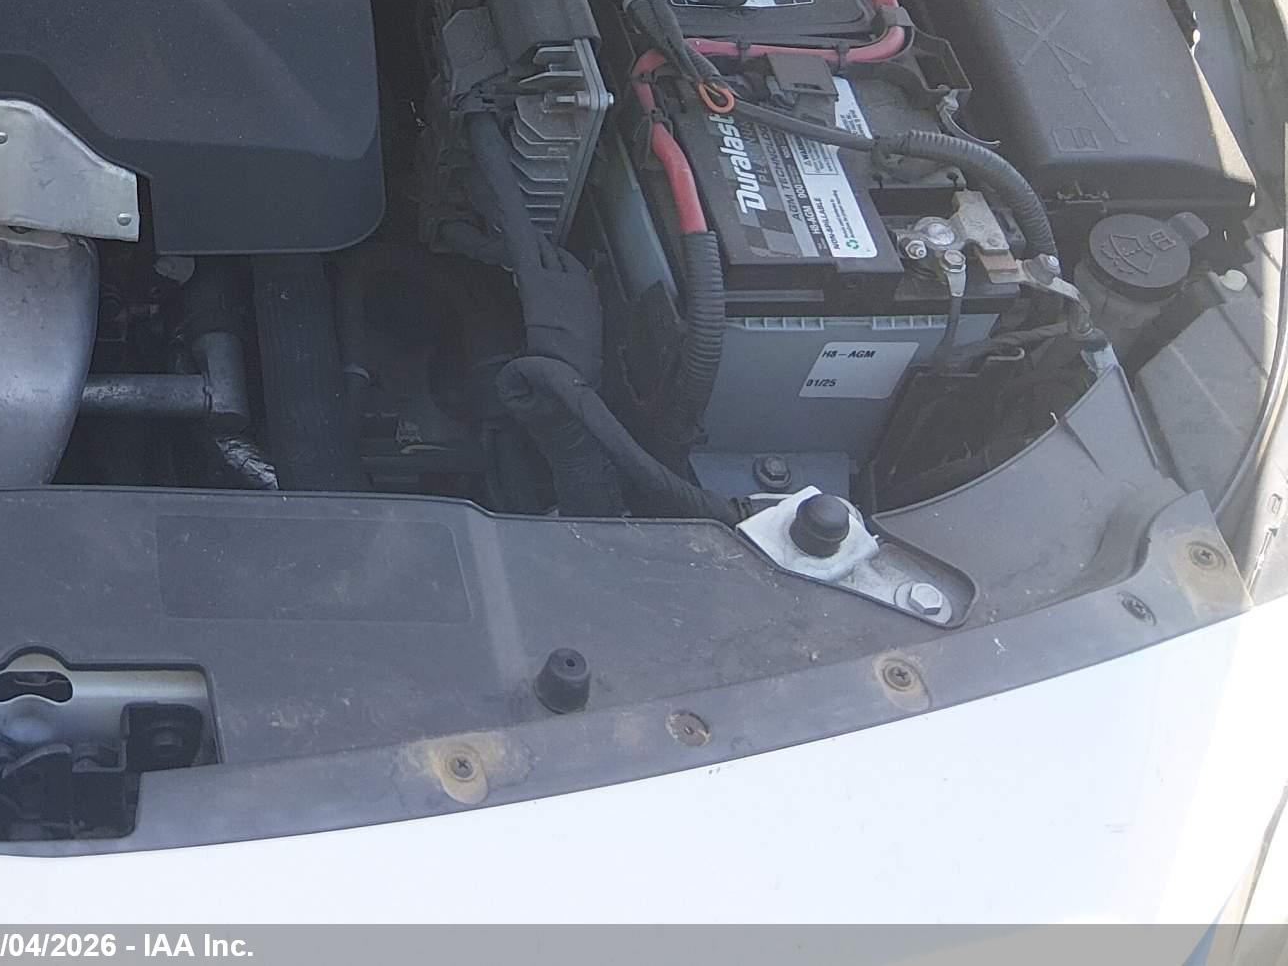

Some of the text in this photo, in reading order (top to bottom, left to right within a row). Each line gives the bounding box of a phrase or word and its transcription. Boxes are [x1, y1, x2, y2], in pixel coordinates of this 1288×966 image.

[709, 113, 767, 215] Duralast
[759, 124, 793, 192] TECHNOLOG
[784, 192, 803, 222] AGM
[801, 205, 824, 235] H8-AGM
[813, 197, 841, 250] NON-SPILLABLE
[806, 379, 837, 387] 01/25
